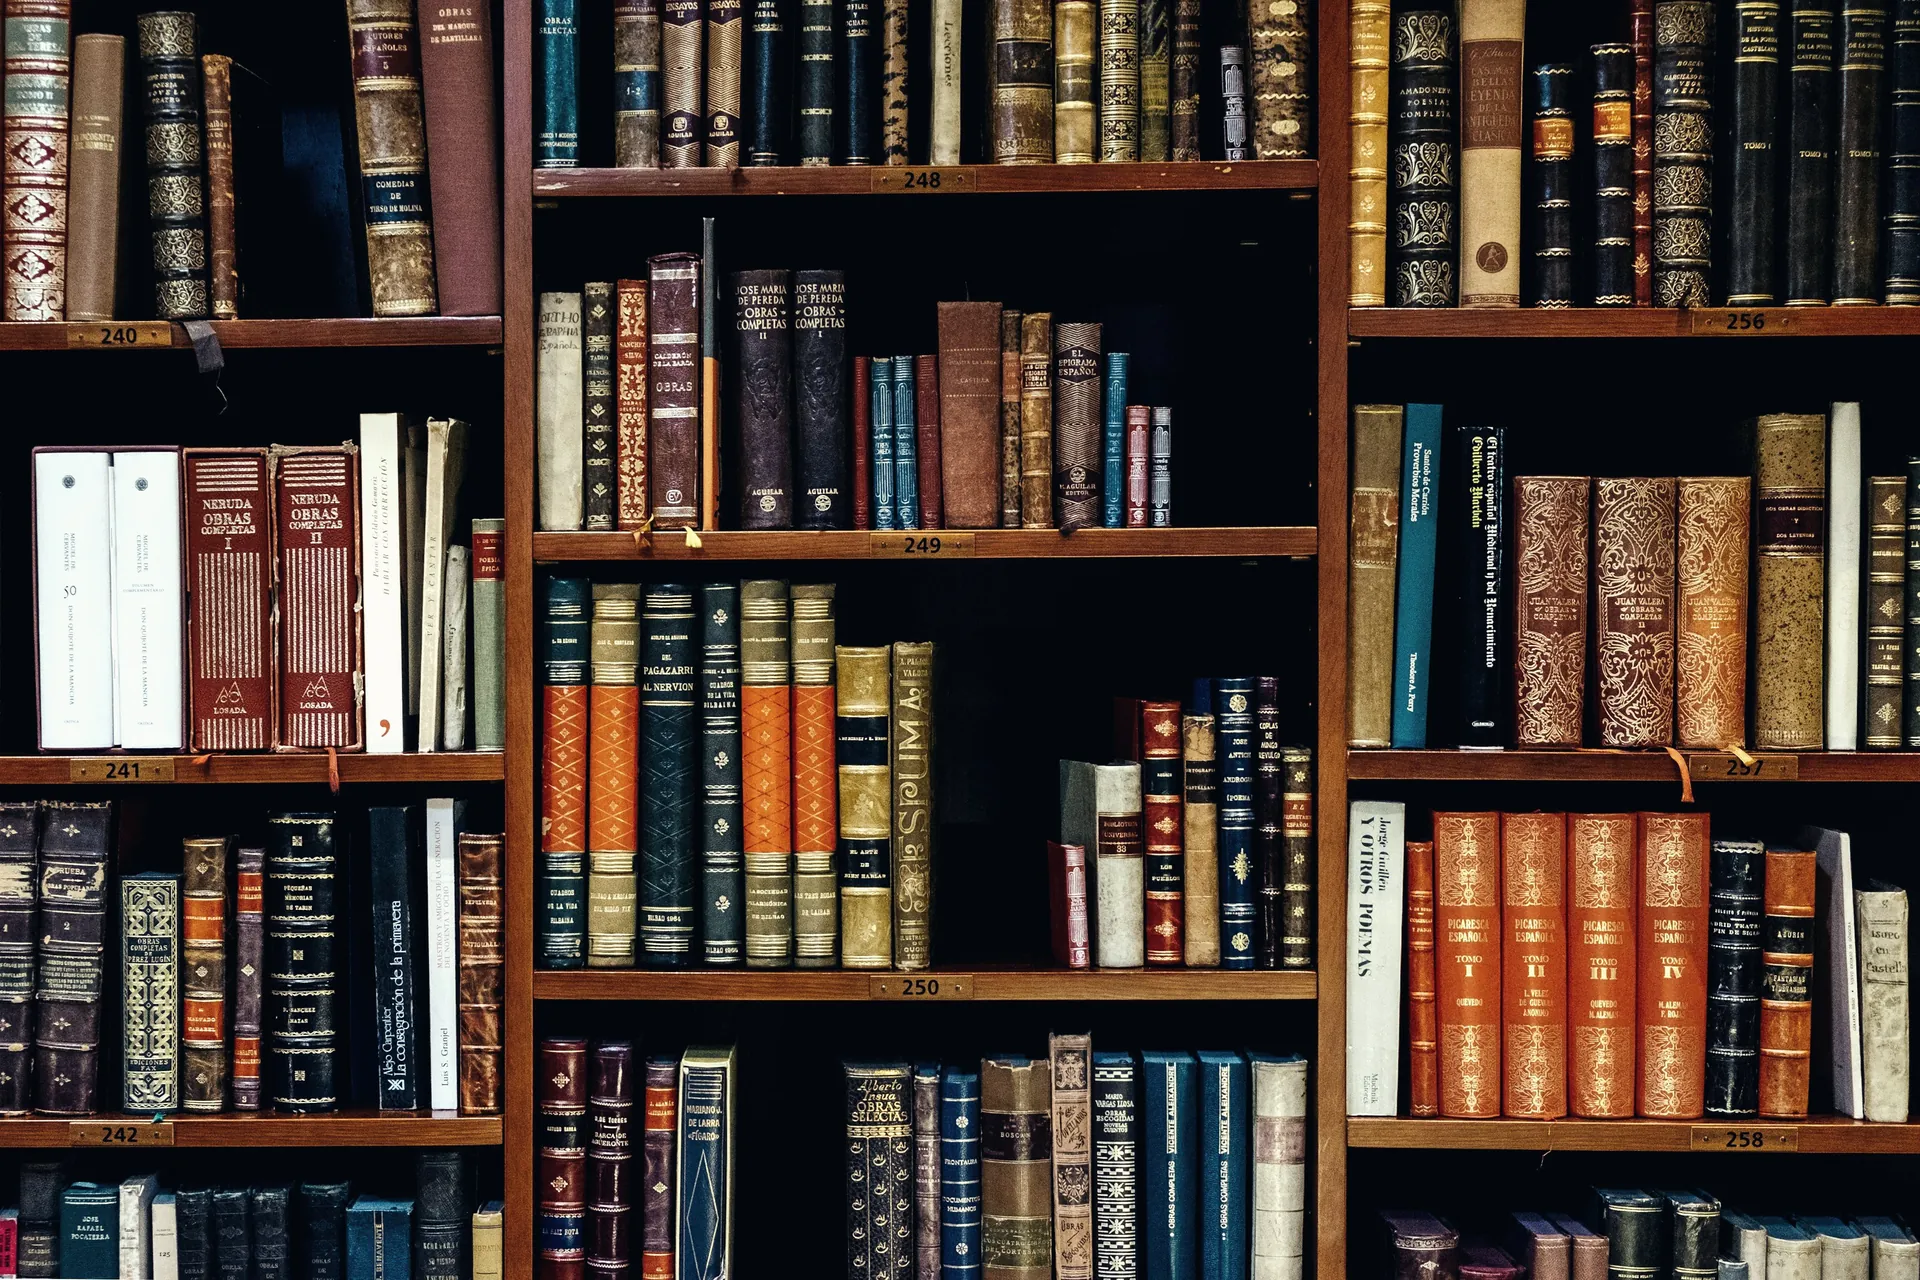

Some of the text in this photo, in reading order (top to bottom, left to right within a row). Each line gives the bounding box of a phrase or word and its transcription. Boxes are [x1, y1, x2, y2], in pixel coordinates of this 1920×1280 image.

[665, 2, 699, 11] ENSAYOS
[439, 8, 472, 17] OBRAS
[544, 17, 572, 25] OBRAS
[539, 27, 578, 35] SELECTAS
[375, 180, 415, 189] COMEDIAS
[905, 172, 942, 188] 248
[735, 284, 788, 295] JOSE MARIA
[794, 283, 846, 294] JOSE MARIA
[738, 294, 785, 305] DE PEREDA
[797, 294, 844, 304] DE PEREDA
[744, 307, 778, 318] OBRAS
[803, 305, 837, 317] OBRAS
[736, 318, 787, 330] COMPLETAS
[795, 317, 846, 329] COMPLETAS
[1727, 313, 1766, 330] 256
[101, 328, 138, 344] 240
[1071, 349, 1084, 357] EL
[1058, 359, 1098, 367] EPIGRAMA
[1058, 366, 1097, 376] ESPAÑOL
[656, 381, 693, 392] OBRAS
[1410, 442, 1423, 522] Proverbios Morales
[1421, 449, 1432, 516] Santob de Carrión
[379, 457, 389, 526] CORRECCIÓN
[752, 488, 784, 496] AGUILAR
[807, 488, 839, 496] AGUILAR
[202, 498, 253, 510] NERUDA
[291, 494, 340, 505] NERUDA
[203, 512, 252, 525] OBRAS
[291, 507, 339, 520] OBRAS
[201, 524, 256, 535] COMPLETAS
[289, 519, 343, 530] COMPLETAS
[224, 537, 232, 550] I
[310, 532, 323, 544] II
[382, 528, 390, 550] CON
[903, 537, 942, 554] 249
[428, 535, 437, 587] CANTAR
[63, 585, 77, 599] 50
[1614, 597, 1666, 606] JUAN VALERA
[1688, 597, 1711, 606] JUAN
[1533, 613, 1577, 621] COMPLETAS
[1619, 613, 1663, 621] COMPLETAS
[427, 614, 435, 636] VER
[643, 666, 694, 675] PAGAZARRI
[642, 682, 694, 691] AL NERVION
[300, 701, 333, 709] LOSADA
[213, 707, 247, 715] LOSADA
[1259, 722, 1279, 730] COPLAS
[1264, 732, 1273, 740] DE
[105, 763, 140, 779] 241
[898, 686, 930, 863] ESPUMA
[1116, 844, 1127, 853] 33
[1378, 817, 1392, 892] Jorge Guillén
[1357, 816, 1375, 978] Y OTROS POEMAS
[63, 922, 70, 931] 2
[1447, 918, 1490, 930] PICARESCA
[1514, 918, 1556, 930] PICARESCA
[1448, 930, 1489, 943] ESPAÑOLA
[1454, 955, 1483, 963] TOMO
[1522, 955, 1550, 963] TOMO
[1589, 957, 1618, 966] TOMO
[1660, 956, 1688, 965] TOMO
[1464, 964, 1474, 978] I
[1527, 964, 1546, 978] II
[1589, 966, 1618, 980] III
[1663, 965, 1686, 979] IV
[389, 899, 410, 1076] La consagración de la primavera
[902, 979, 939, 996] 250
[440, 1027, 449, 1087] Luis S. Granjel
[857, 1079, 903, 1091] Alberto
[862, 1091, 896, 1101] Insua
[856, 1101, 901, 1112] OBRAS
[1095, 1099, 1135, 1108] VARGAS LLOSA
[686, 1105, 723, 1114] MARIANO J.
[1166, 1065, 1176, 1154] VICENTE ALEIXANDRE
[1220, 1066, 1229, 1155] VICENTE ALEIXANDRE
[851, 1111, 908, 1122] SELECTAS
[688, 1118, 720, 1127] DE LARRA
[102, 1127, 138, 1143] 242
[1726, 1132, 1764, 1148] 258
[1167, 1160, 1176, 1229] OBRAS COMPLETAS
[1220, 1160, 1229, 1229] OBRAS COMPLETAS
[374, 1223, 383, 1273] BENAVENTE
